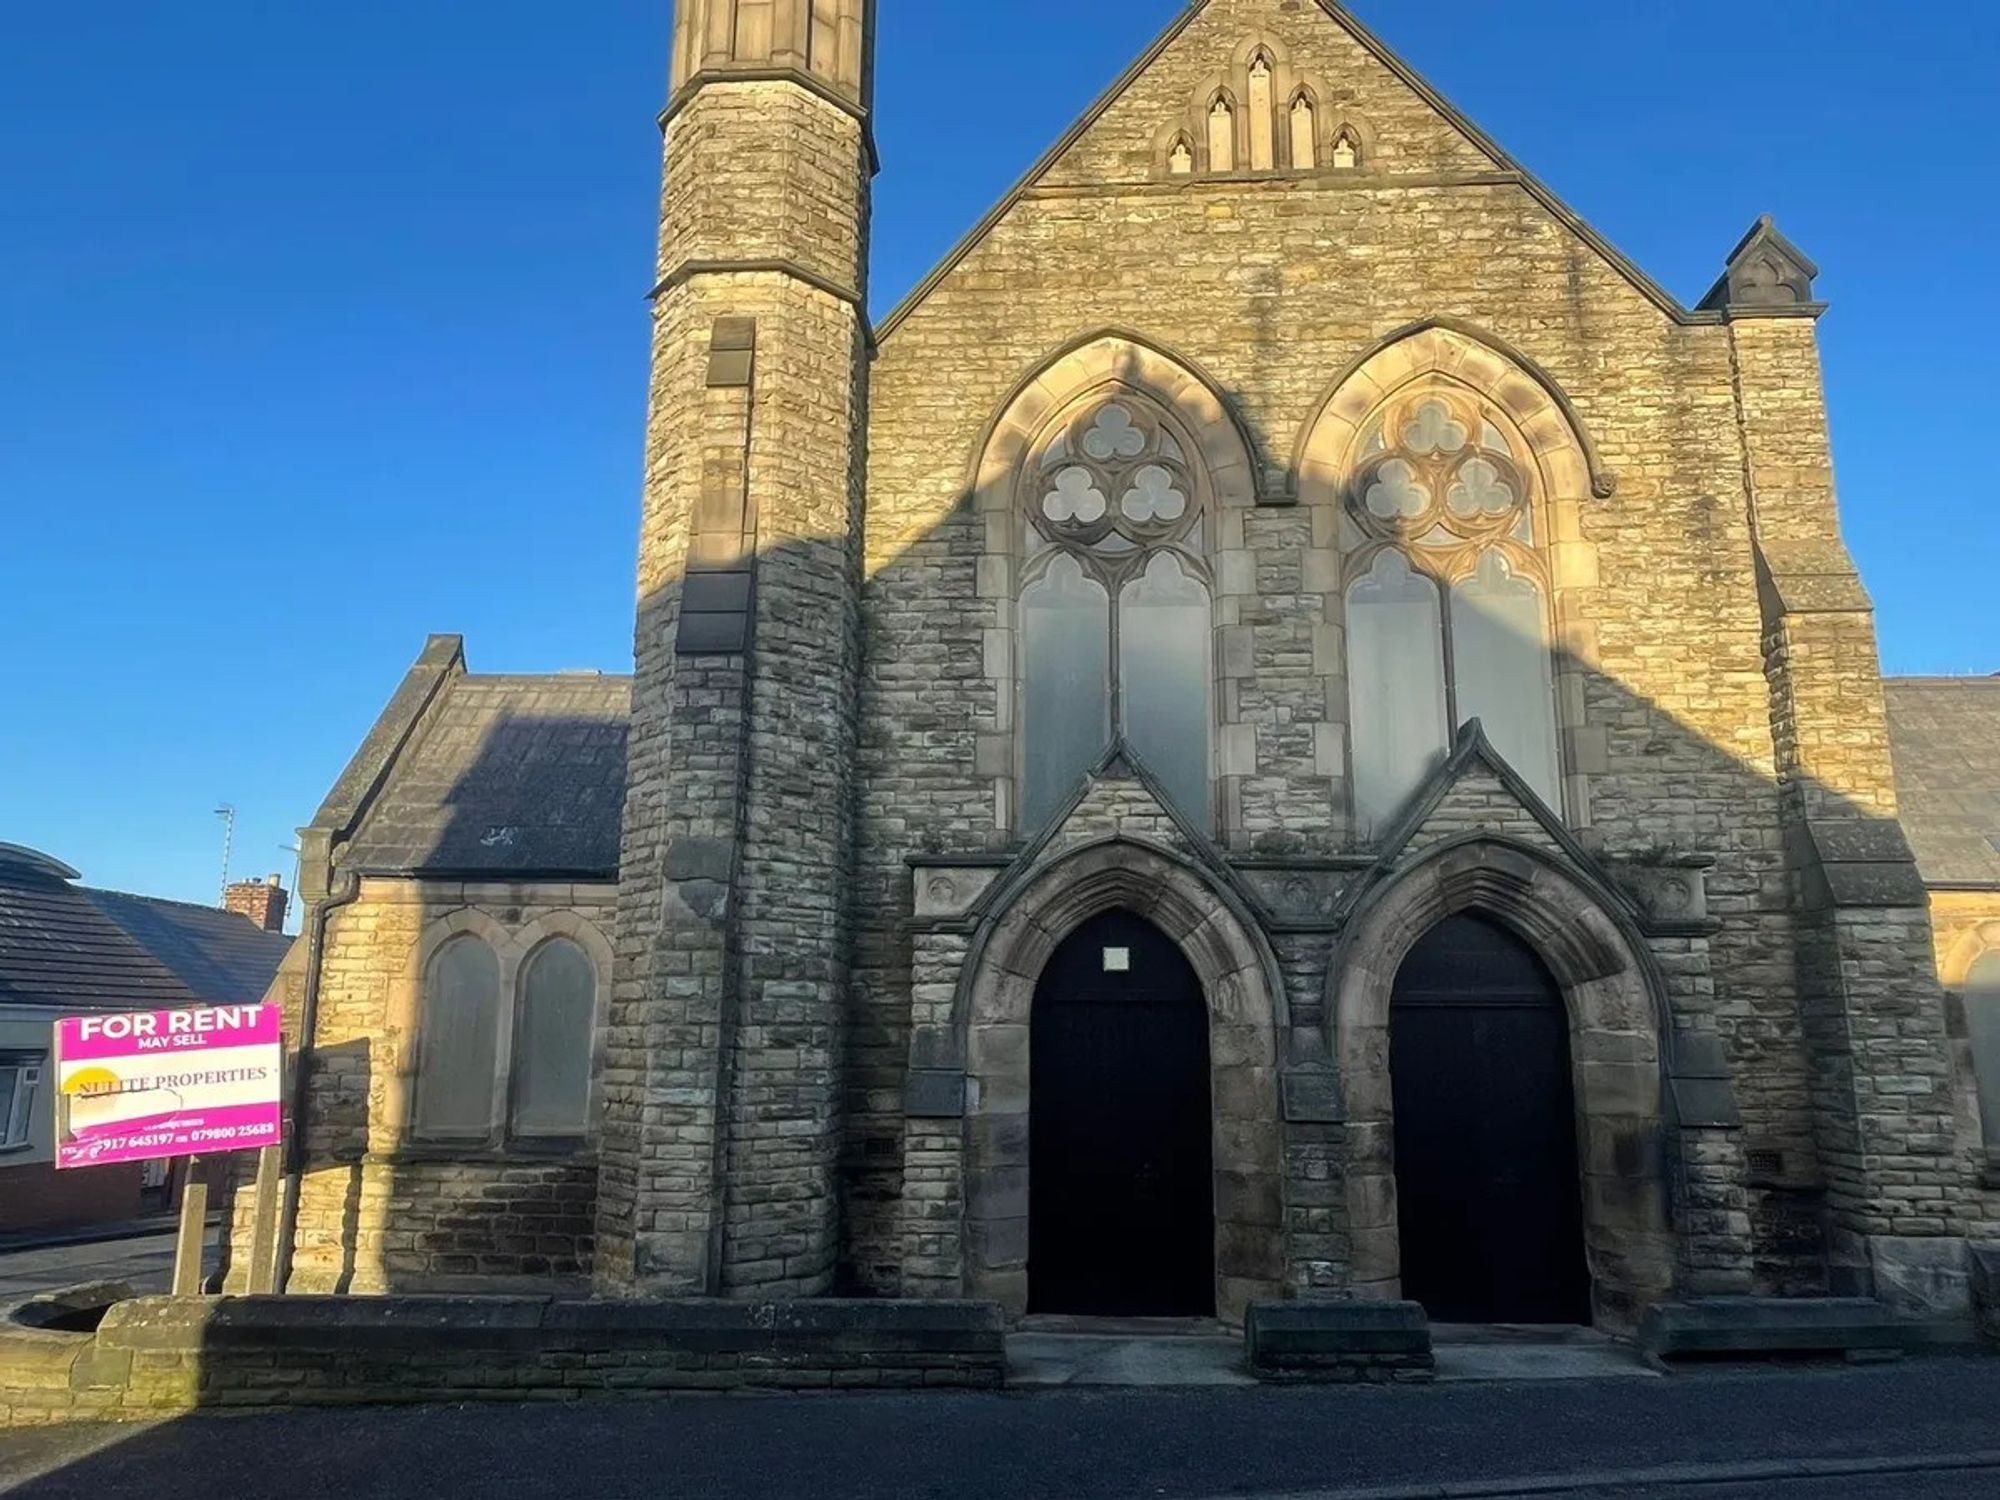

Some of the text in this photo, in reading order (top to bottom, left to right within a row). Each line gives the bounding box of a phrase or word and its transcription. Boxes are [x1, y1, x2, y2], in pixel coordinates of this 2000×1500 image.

[80, 1006, 263, 1041] FOR RENT
[138, 1034, 207, 1050] MAY SELL
[156, 1067, 267, 1089] PROPERTIES
[128, 1133, 175, 1147] 645197
[191, 1128, 236, 1142] 079800
